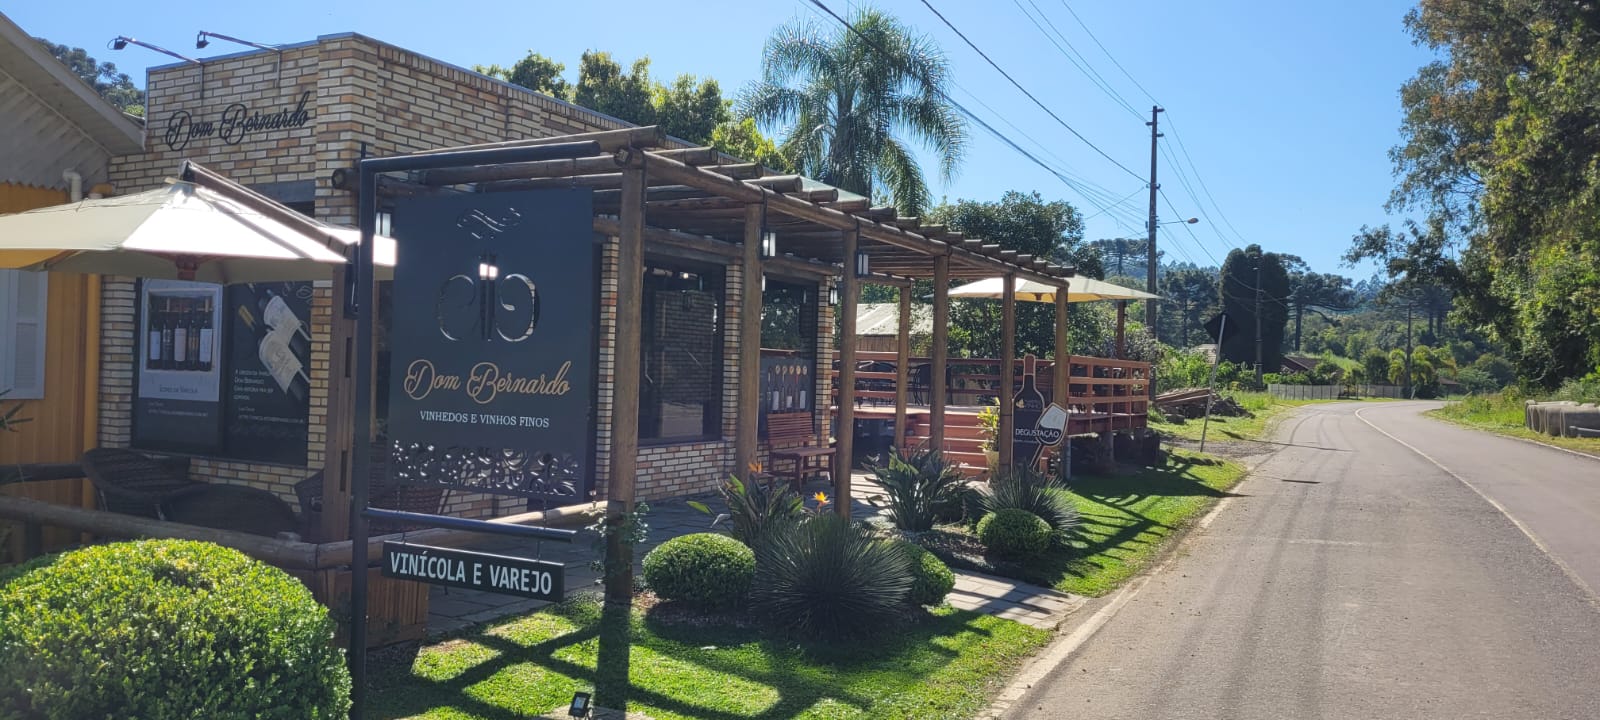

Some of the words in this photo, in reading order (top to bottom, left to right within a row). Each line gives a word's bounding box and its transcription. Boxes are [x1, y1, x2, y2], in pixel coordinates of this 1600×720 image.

[165, 110, 216, 151] Dom
[219, 90, 311, 145] Bernardo
[404, 359, 461, 400] Dom
[466, 361, 572, 404] Bernardo
[420, 411, 468, 423] VINHEDOS
[471, 414, 477, 424] E
[480, 414, 517, 426] VINHOS
[519, 416, 550, 428] FINOS
[1015, 428, 1060, 438] DEGUSTAÇÃO
[390, 551, 466, 583] VINÍCOLA
[473, 563, 482, 585] E
[489, 564, 552, 595] VAREJO
